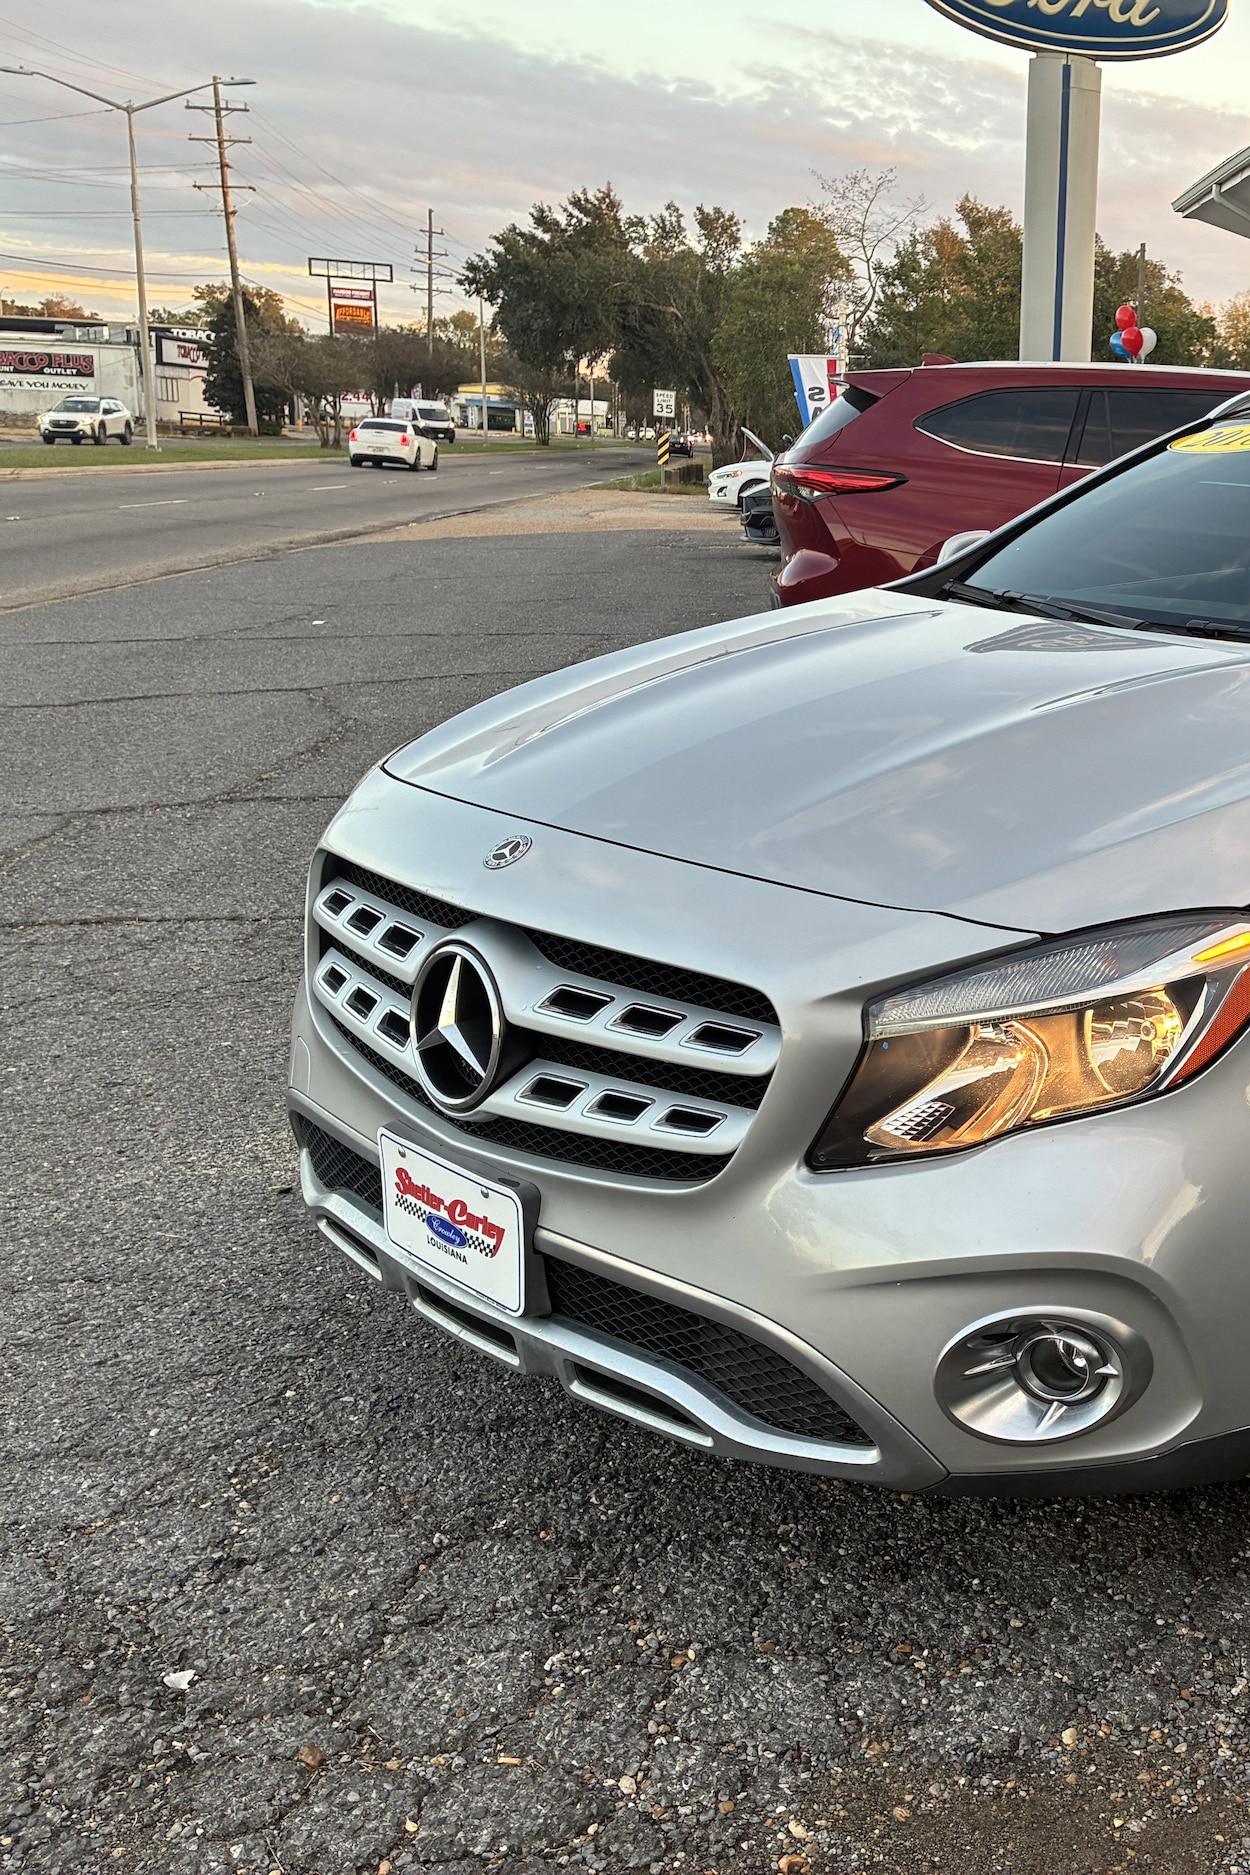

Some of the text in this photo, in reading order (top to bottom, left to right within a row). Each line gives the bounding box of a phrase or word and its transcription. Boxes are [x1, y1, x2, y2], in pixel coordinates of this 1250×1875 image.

[171, 328, 217, 344] TOBAC
[43, 367, 78, 375] OUTLET
[51, 353, 94, 374] PLUS
[26, 381, 49, 389] YOU
[51, 382, 89, 390] MONEY
[656, 403, 673, 414] 35
[394, 1167, 506, 1258] Shetler-Corley
[431, 1216, 461, 1246] Crowley
[426, 1234, 468, 1265] LOUISIANA
